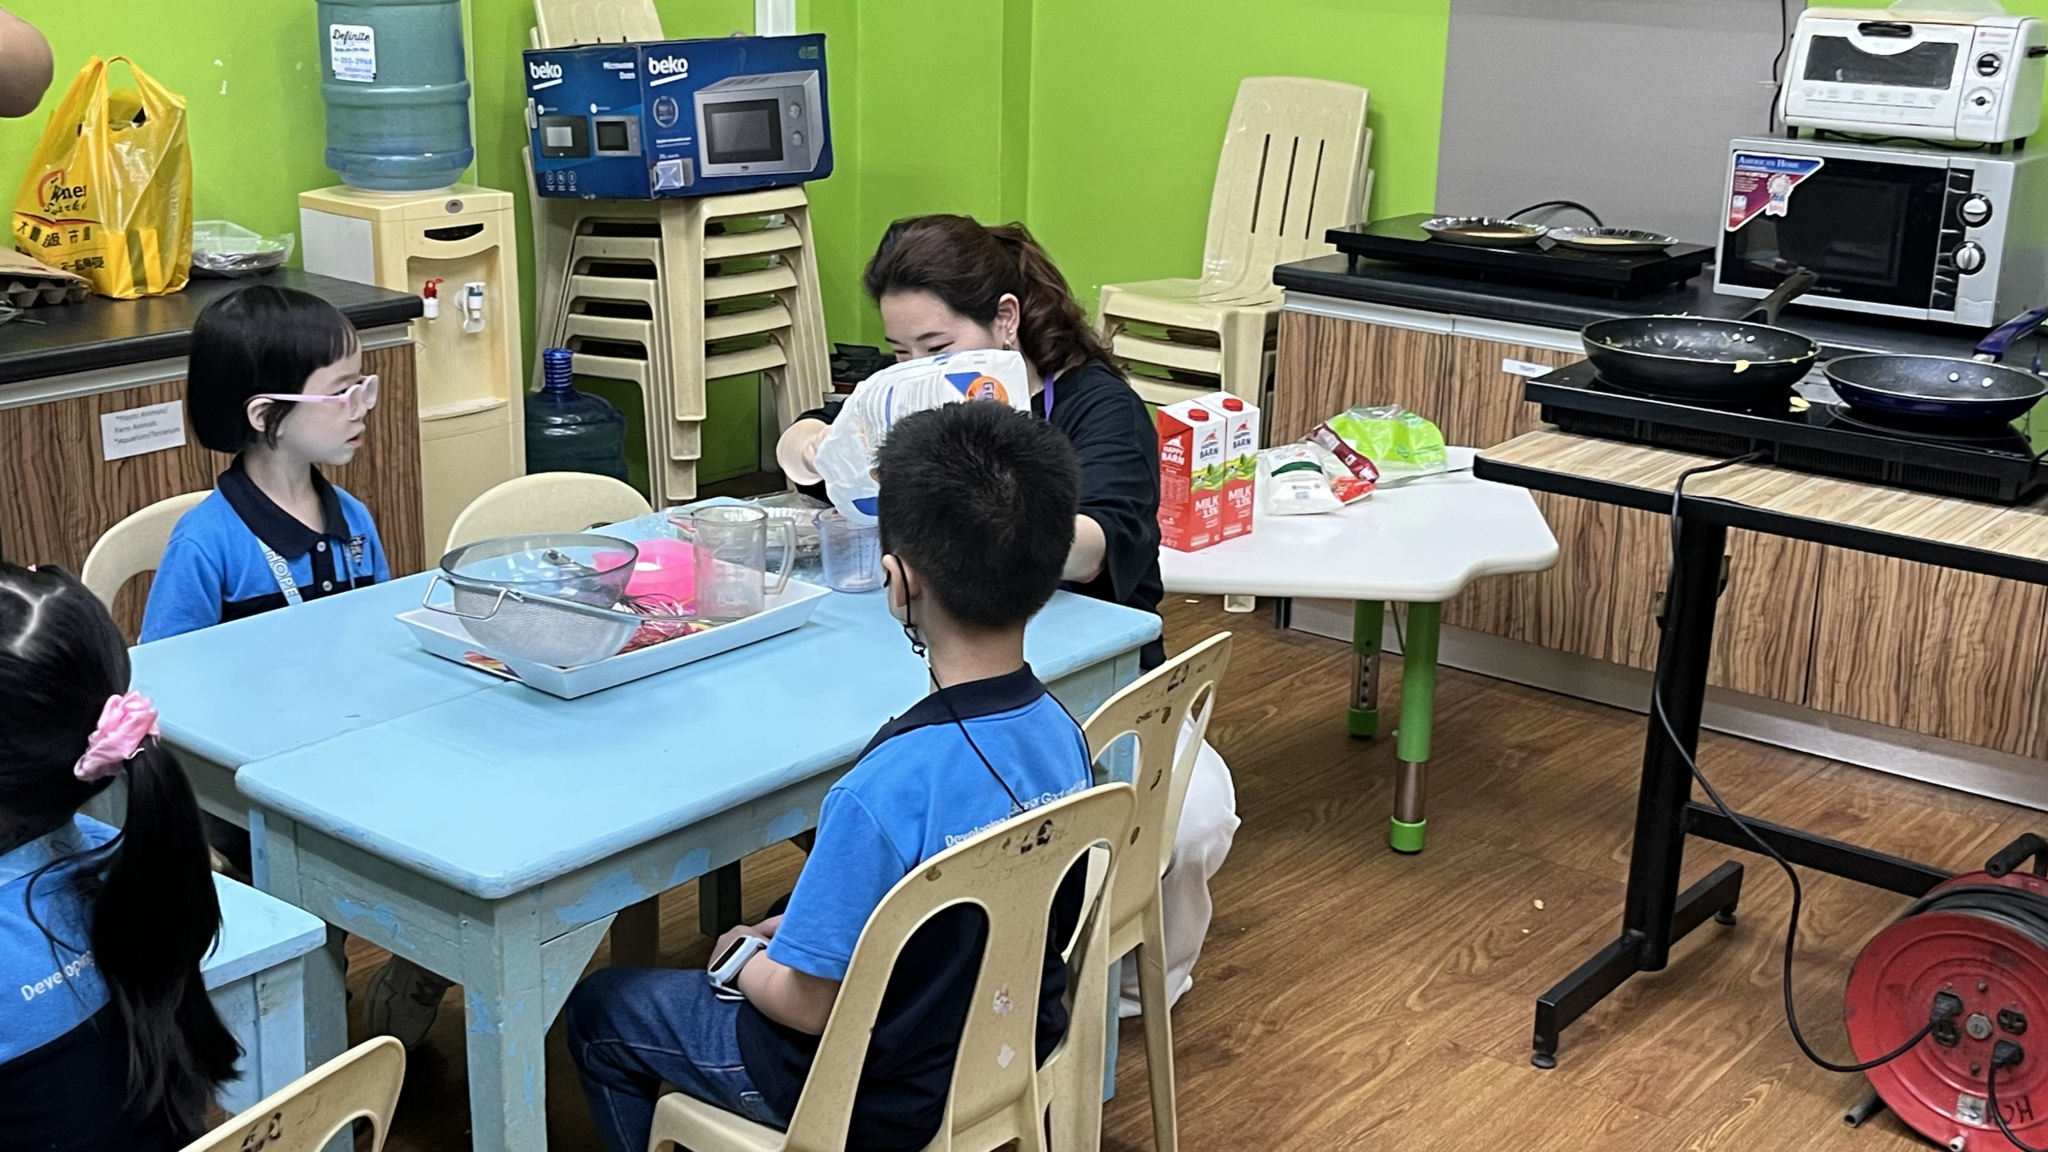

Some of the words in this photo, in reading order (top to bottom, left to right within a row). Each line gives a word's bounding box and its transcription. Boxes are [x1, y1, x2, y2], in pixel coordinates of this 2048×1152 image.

[332, 28, 371, 46] Definite
[529, 61, 563, 79] beko
[648, 55, 688, 75] beko
[1200, 447, 1219, 459] BARN
[1233, 438, 1252, 450] BARN
[1161, 451, 1185, 466] BARN
[1228, 484, 1252, 501] MILK
[1195, 494, 1219, 512] MILK
[265, 549, 299, 598] HOPE
